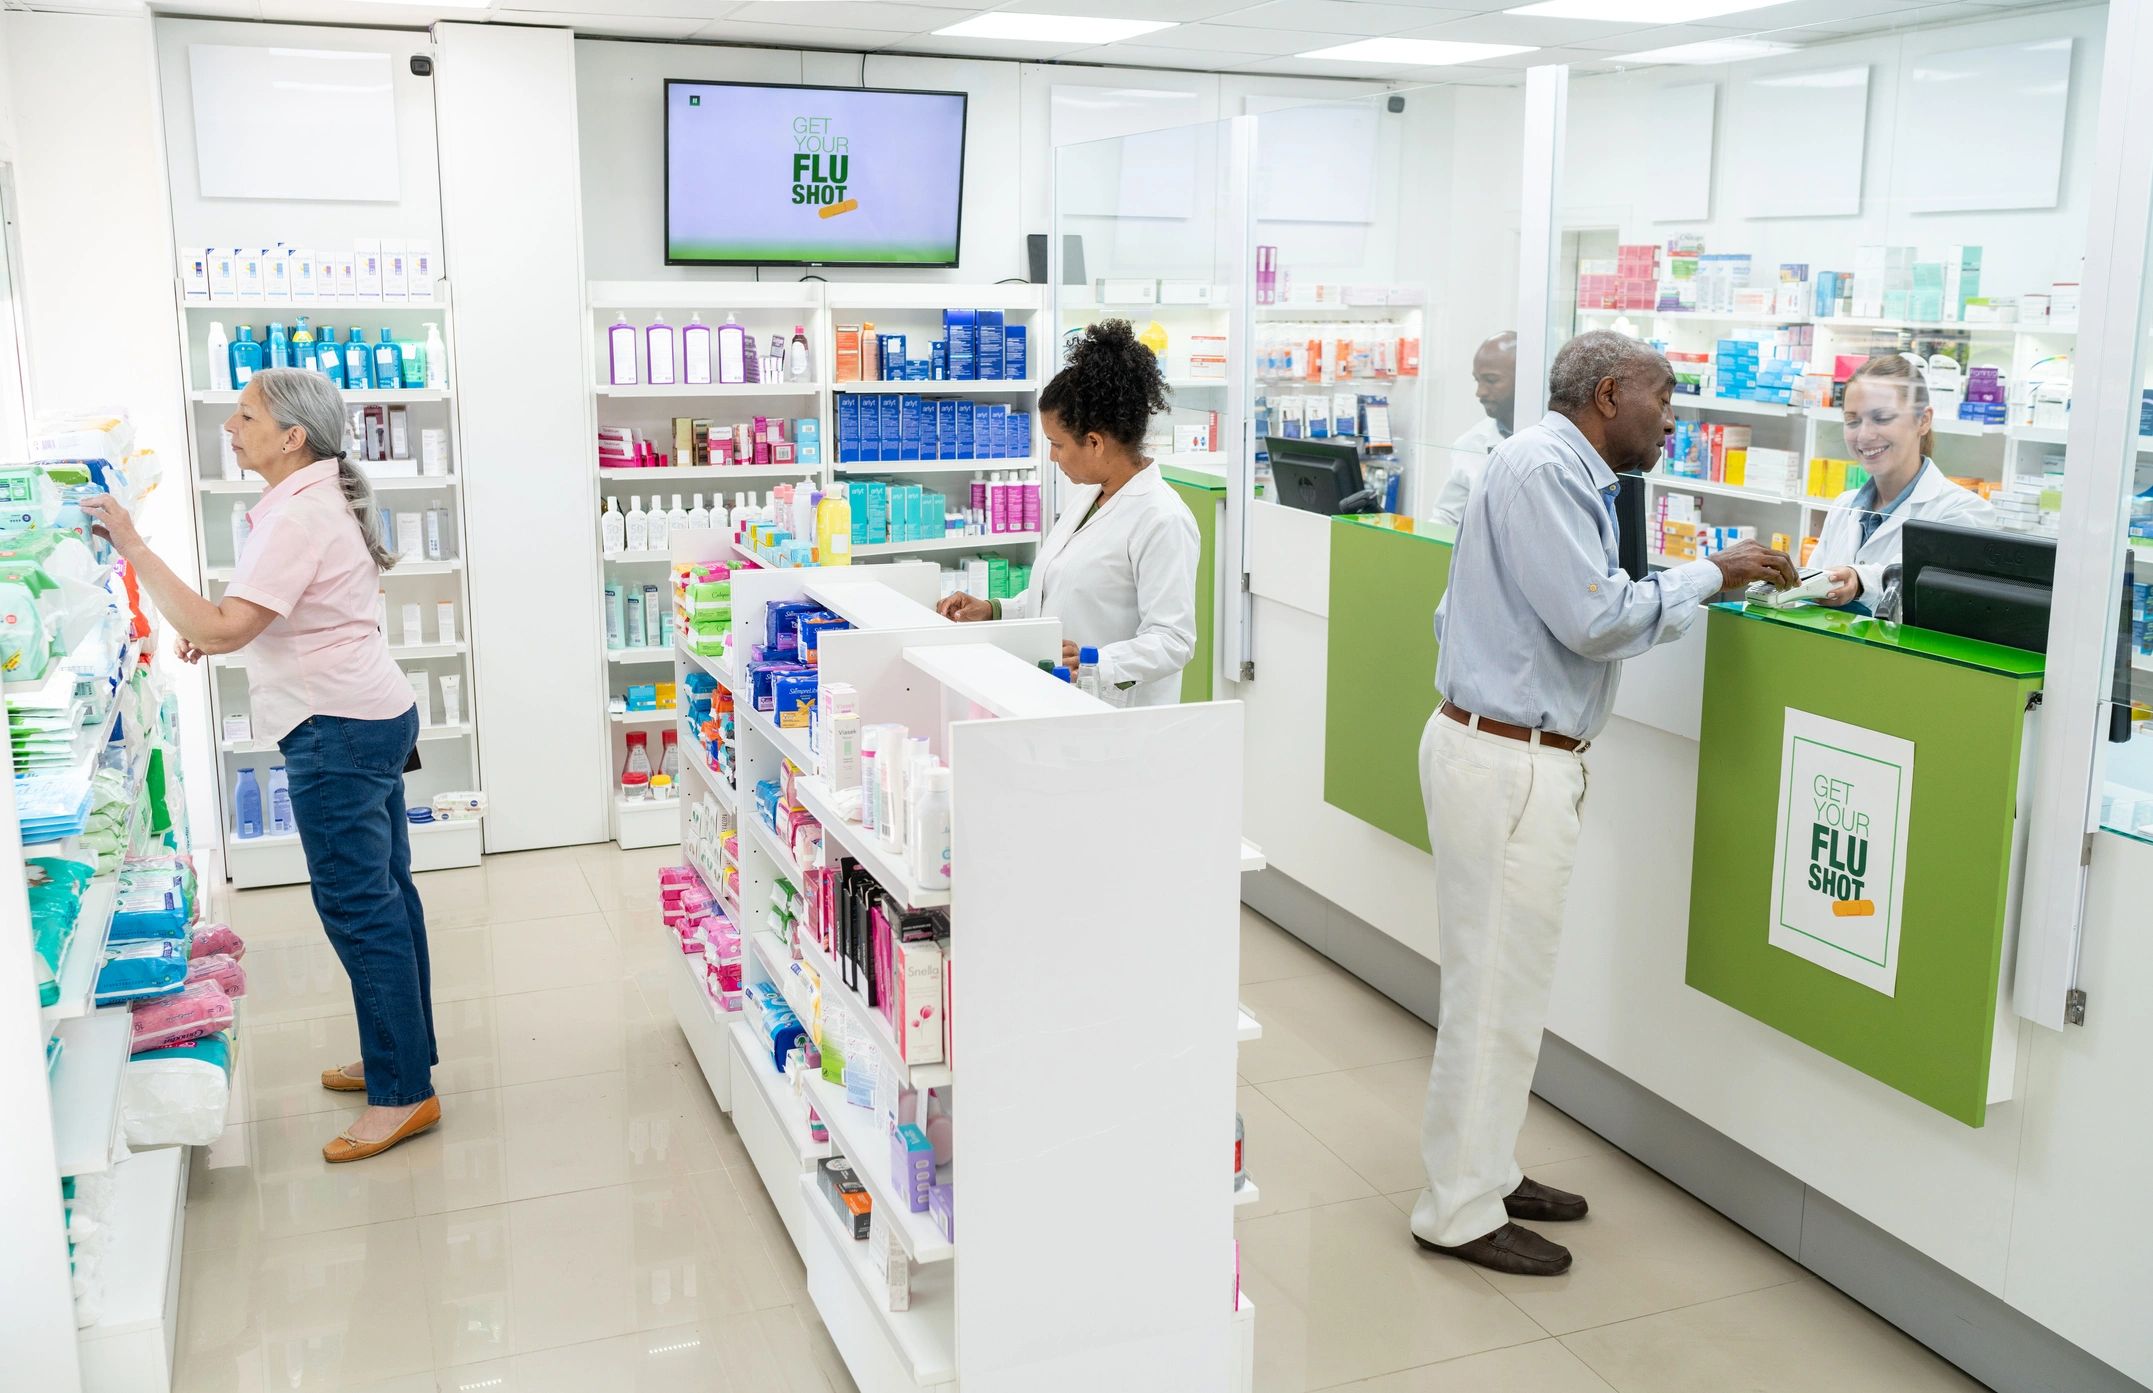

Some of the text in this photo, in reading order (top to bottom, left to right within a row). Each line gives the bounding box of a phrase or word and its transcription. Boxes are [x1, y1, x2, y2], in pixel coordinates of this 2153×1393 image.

[793, 117, 832, 135] GET
[793, 135, 849, 154] YOUR
[792, 153, 849, 184] FLU
[791, 184, 848, 206] SHOT
[1813, 774, 1855, 805] GET
[1813, 797, 1870, 838] YOUR
[1811, 822, 1868, 878] FLU
[1808, 863, 1865, 902] SHOT
[908, 965, 939, 977] Snella
